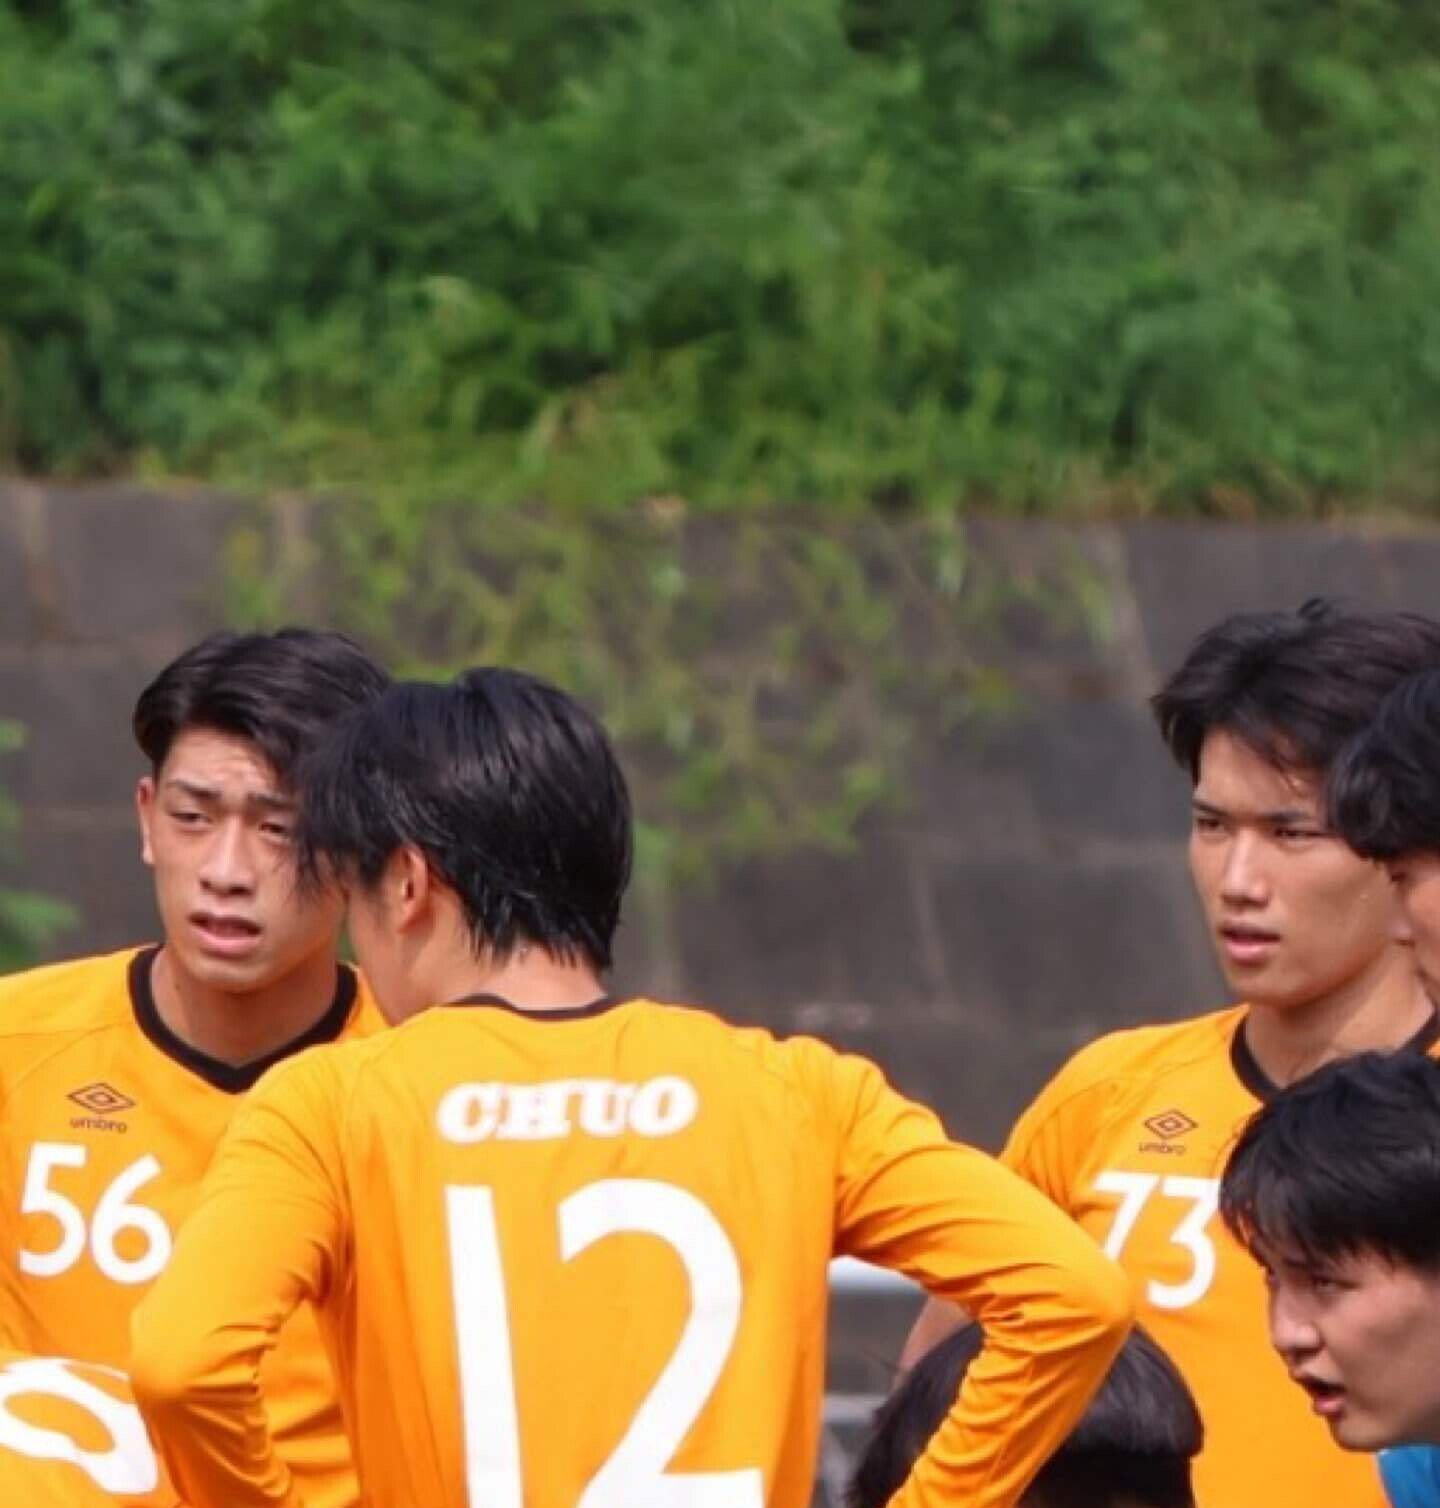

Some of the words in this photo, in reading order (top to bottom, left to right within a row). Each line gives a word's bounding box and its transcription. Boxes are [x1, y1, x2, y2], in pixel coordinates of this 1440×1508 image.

[436, 1075, 699, 1144] CHUO
[19, 1141, 173, 1285] 56
[1093, 1170, 1220, 1310] 73
